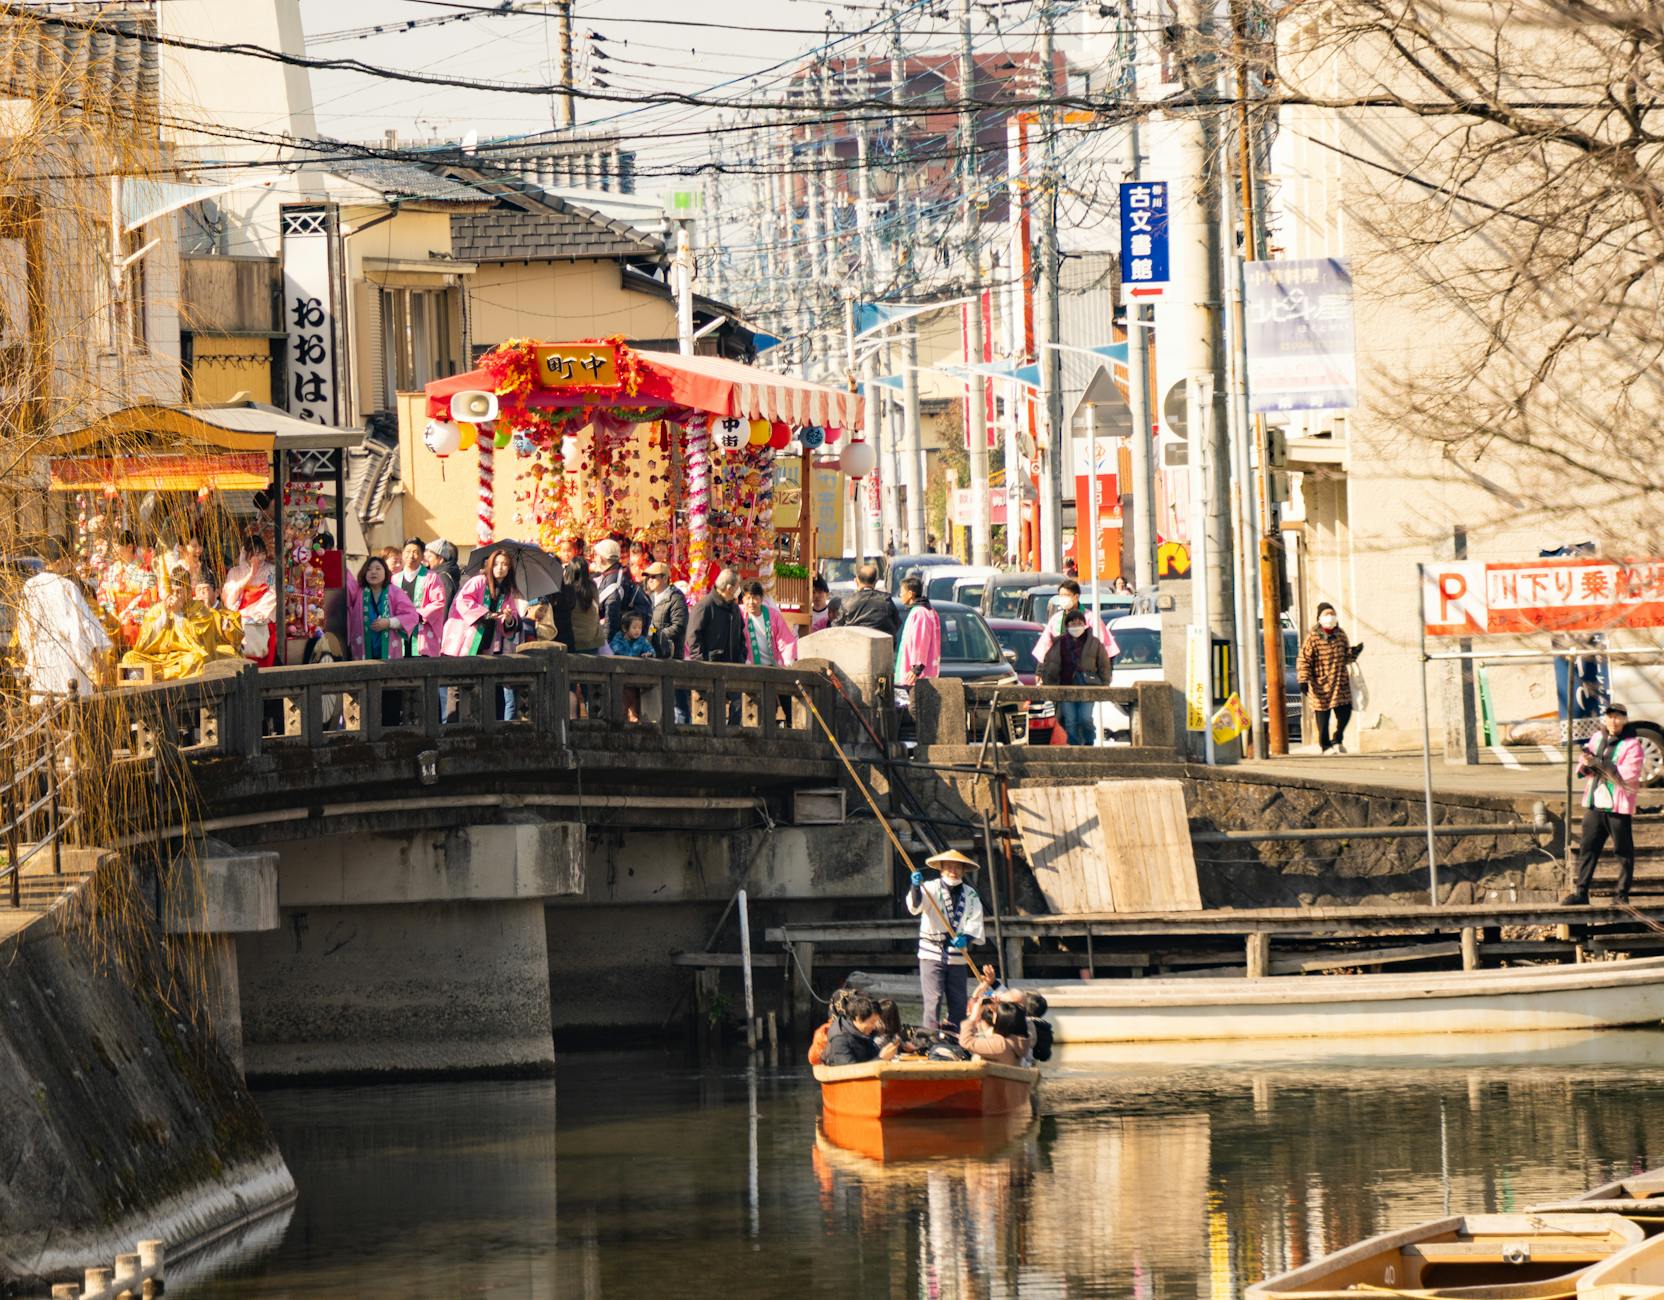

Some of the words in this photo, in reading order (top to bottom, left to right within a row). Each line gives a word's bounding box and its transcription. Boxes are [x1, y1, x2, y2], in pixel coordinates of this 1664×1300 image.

[1128, 185, 1153, 280] 古文書館
[1439, 572, 1467, 621] P
